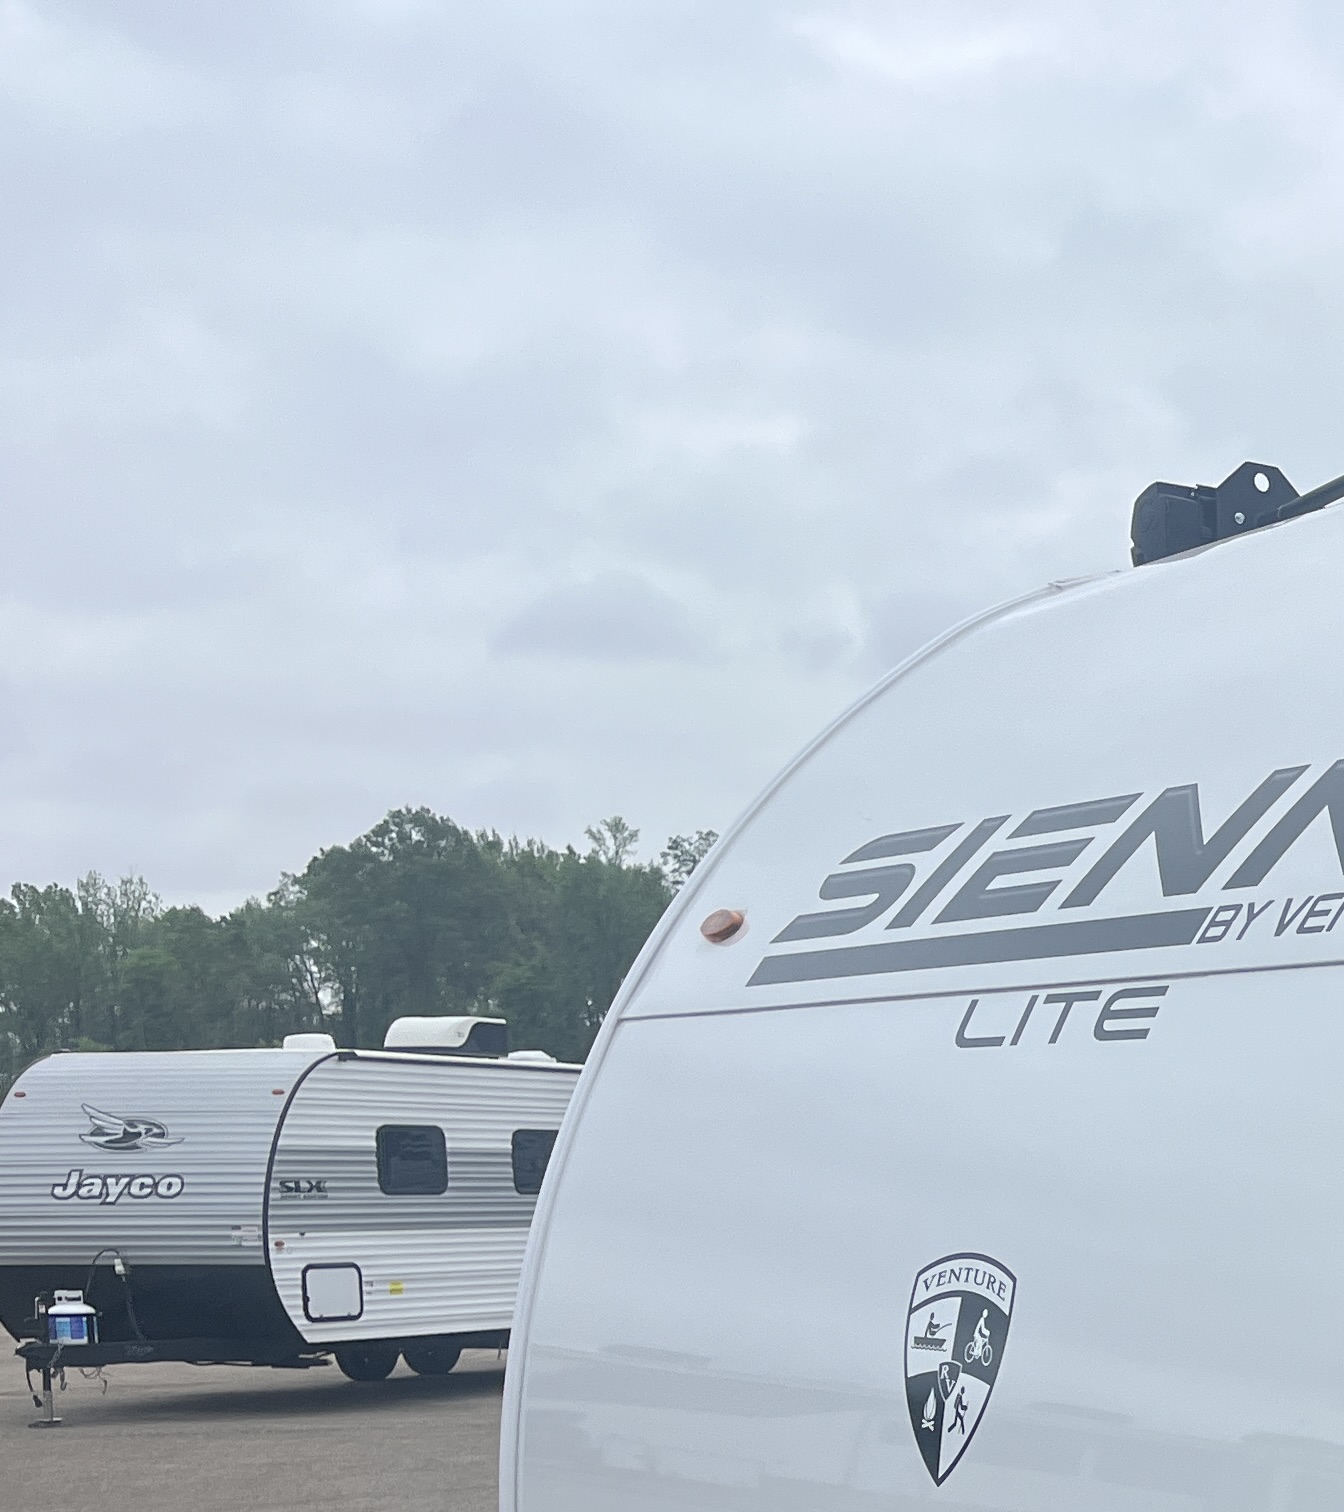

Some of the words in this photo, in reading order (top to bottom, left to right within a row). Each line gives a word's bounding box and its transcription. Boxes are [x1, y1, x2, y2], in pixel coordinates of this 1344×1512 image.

[1196, 899, 1275, 944] BY
[955, 985, 1169, 1048] LITE
[51, 1169, 184, 1205] Jayco
[923, 1267, 1007, 1302] VENTURE
